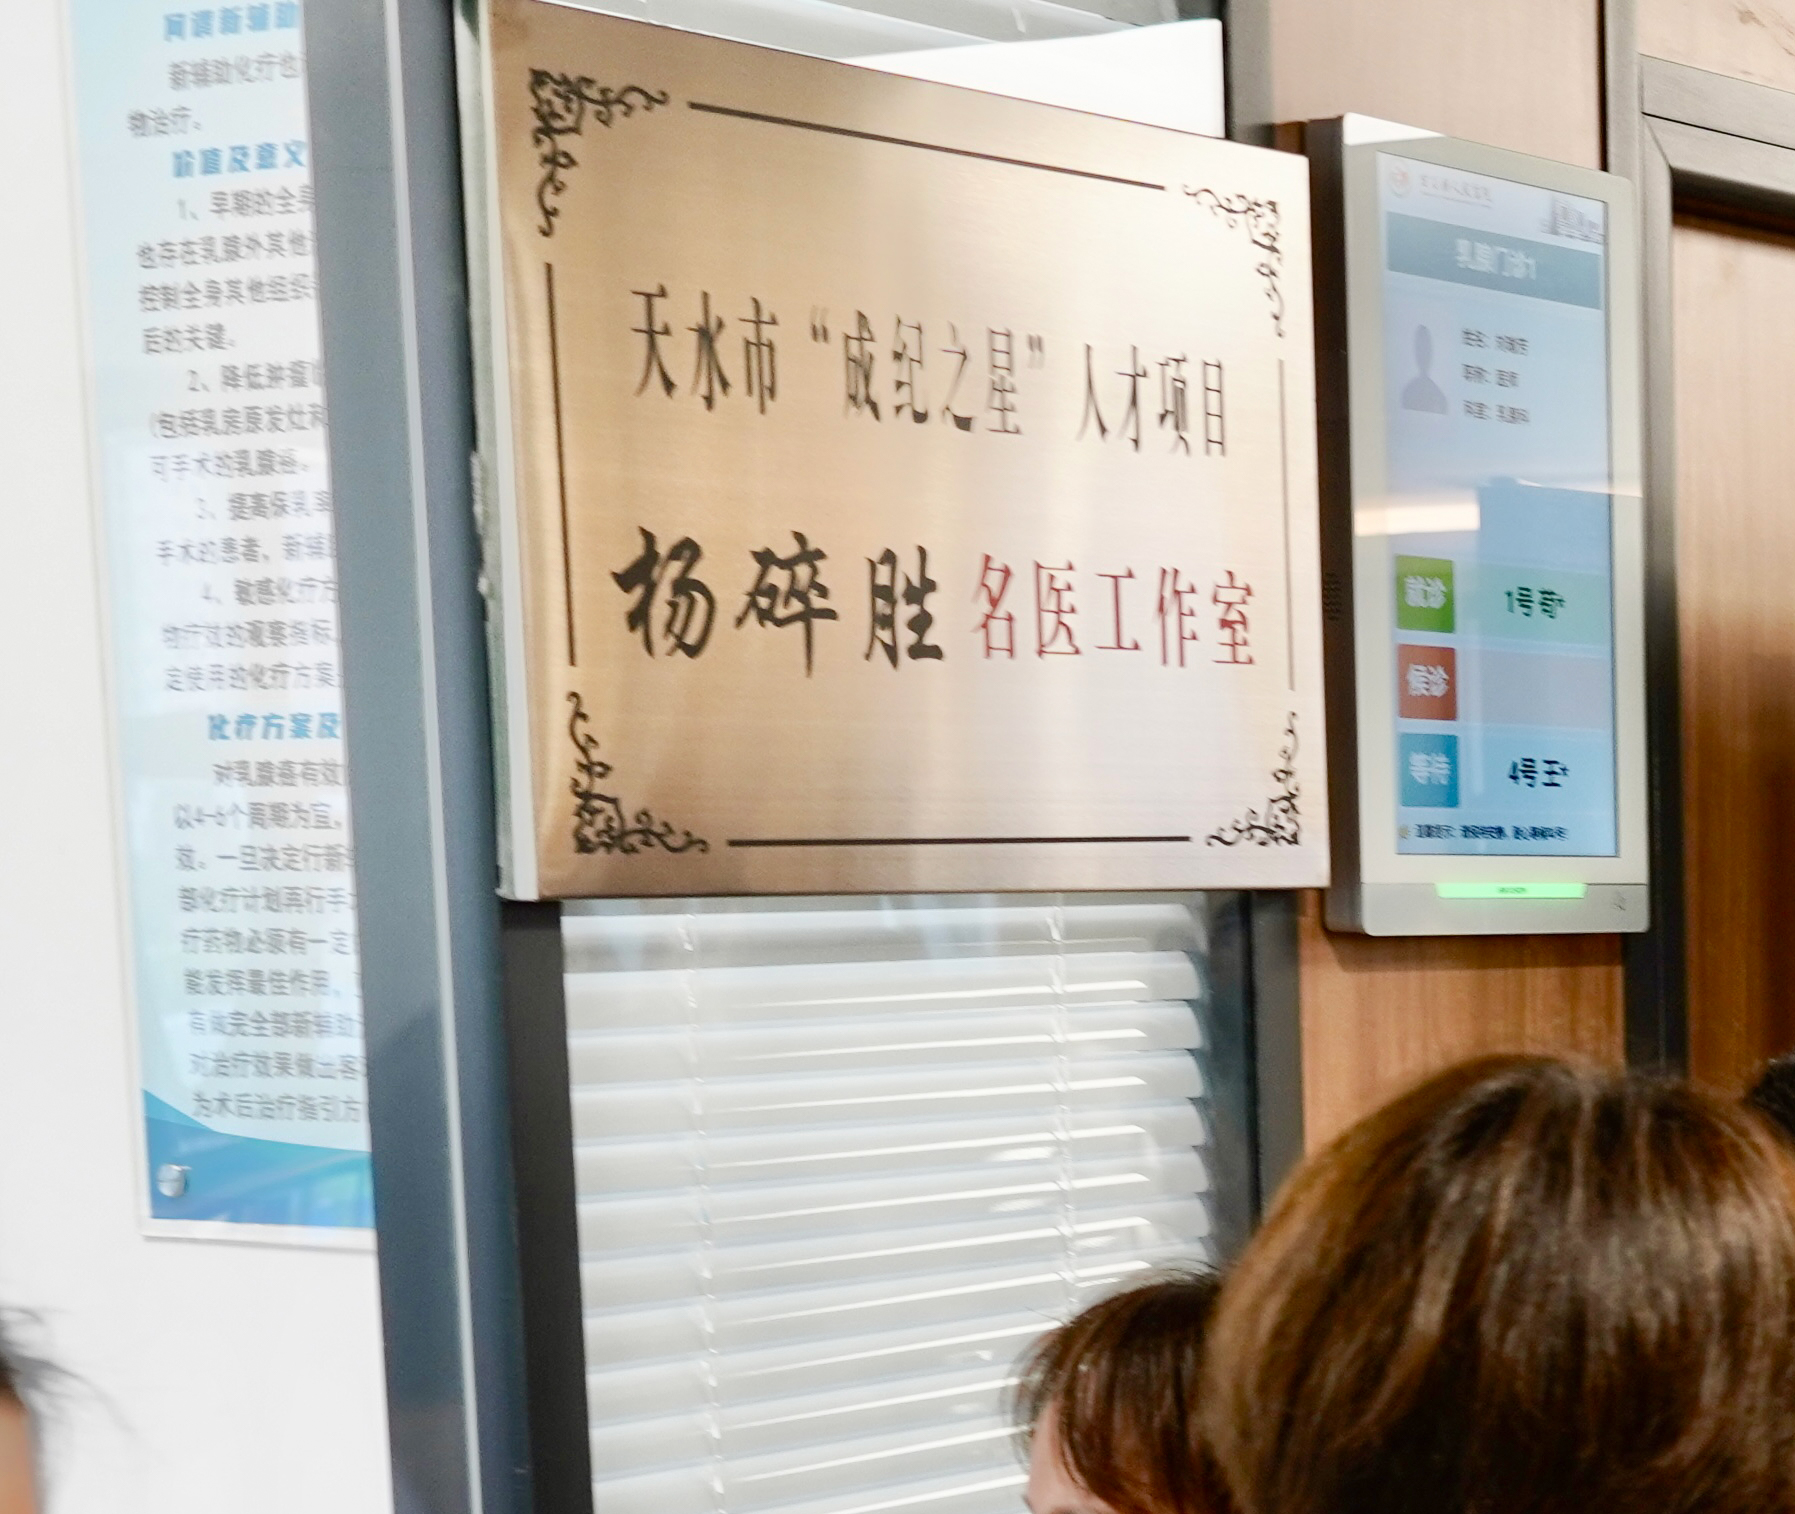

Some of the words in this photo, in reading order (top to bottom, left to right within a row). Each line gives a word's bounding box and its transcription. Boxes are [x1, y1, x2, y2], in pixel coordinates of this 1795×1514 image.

[167, 51, 306, 91] 新辅助化疗也
[136, 228, 318, 269] 也存在乳腺外其他
[177, 885, 356, 914] 部化疗计划再行手
